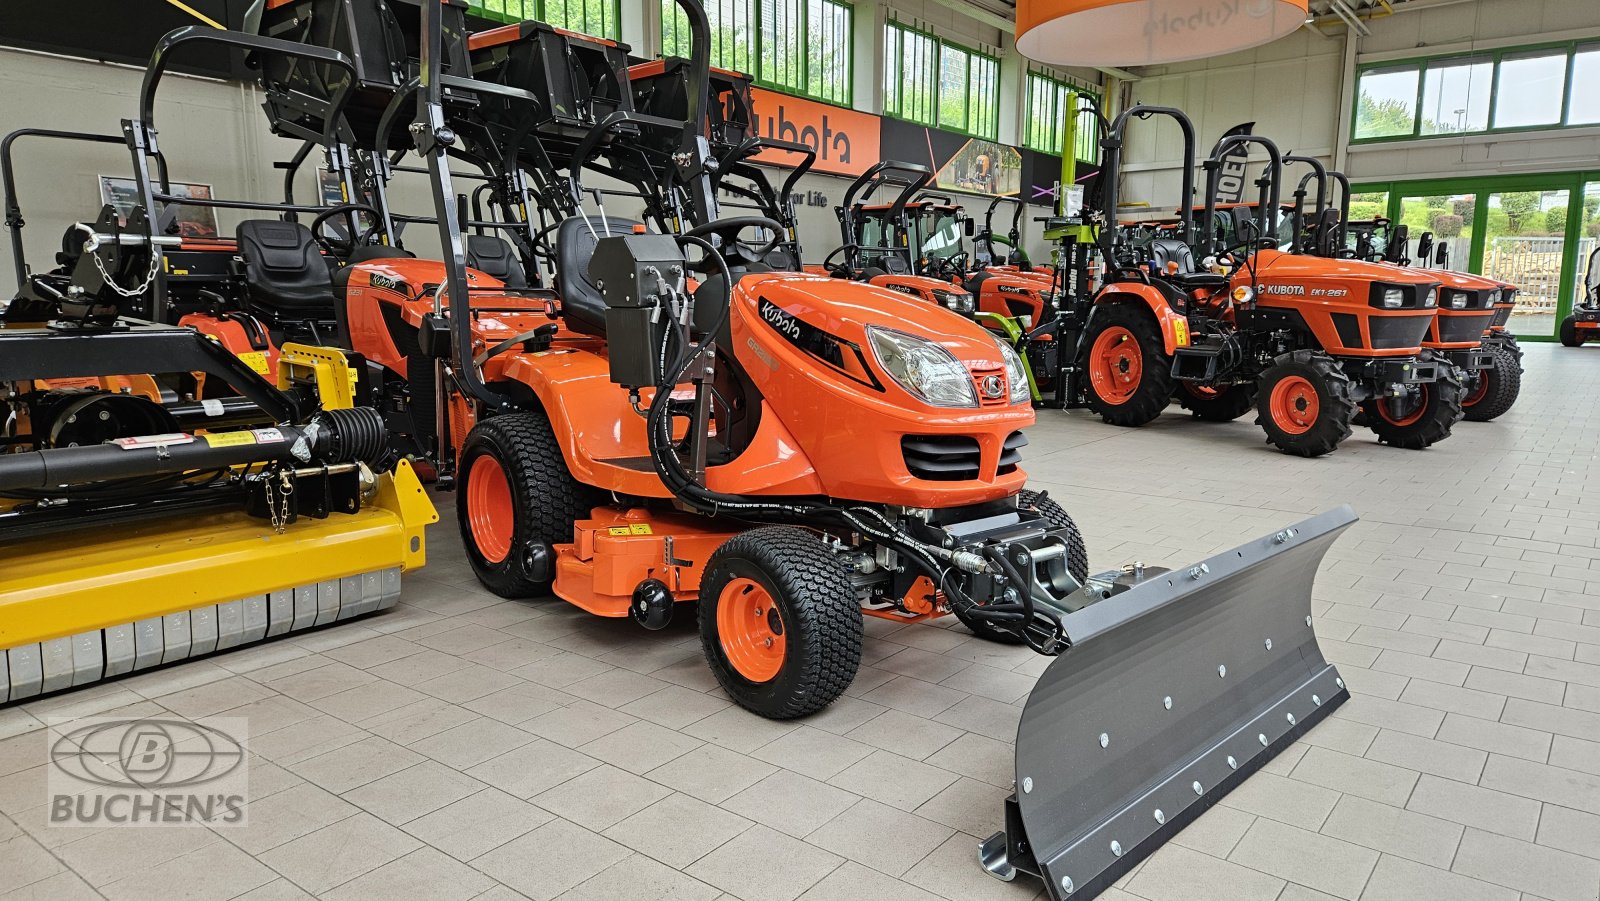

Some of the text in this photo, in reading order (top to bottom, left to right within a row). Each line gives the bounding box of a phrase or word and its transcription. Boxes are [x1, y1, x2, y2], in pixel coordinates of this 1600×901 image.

[807, 190, 828, 208] Life
[372, 274, 396, 289] Kubota
[1267, 285, 1348, 297] KUBOTA EK1-261
[762, 302, 801, 339] Kubota
